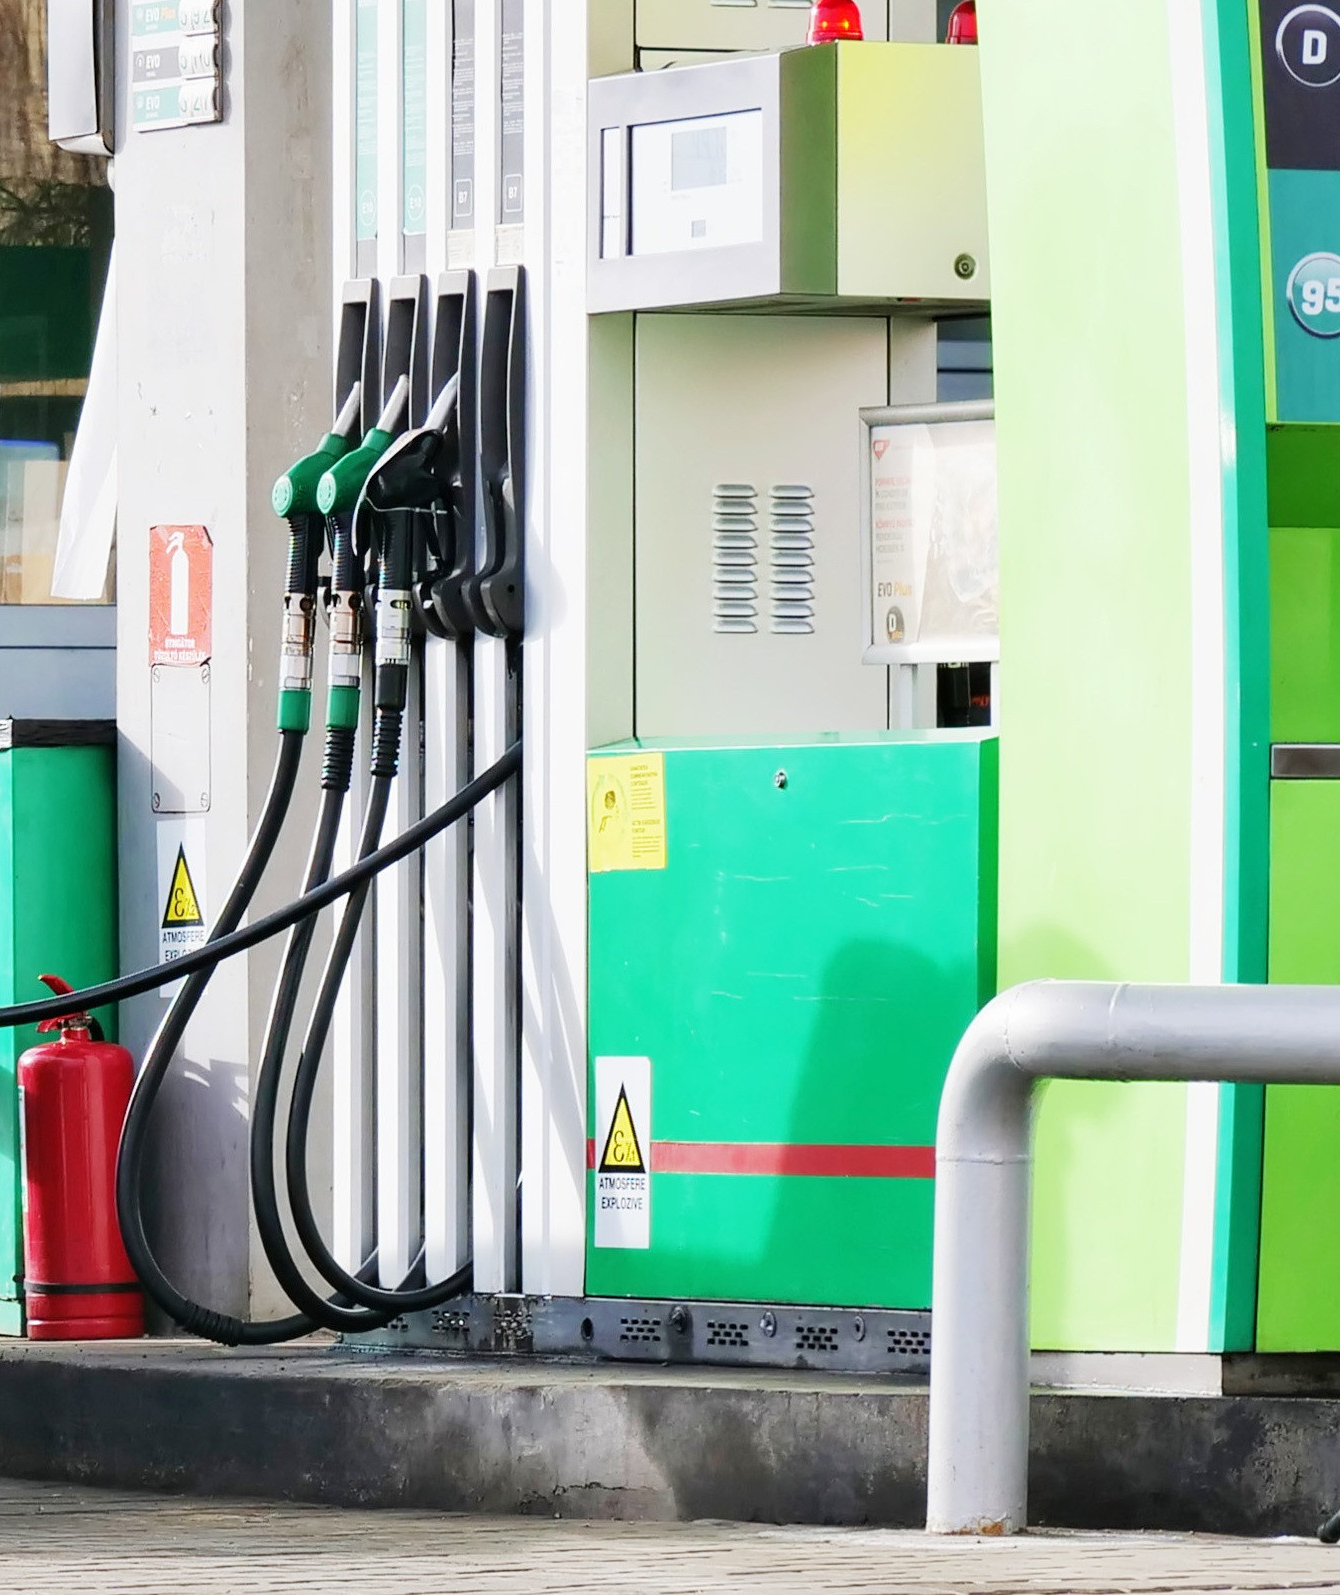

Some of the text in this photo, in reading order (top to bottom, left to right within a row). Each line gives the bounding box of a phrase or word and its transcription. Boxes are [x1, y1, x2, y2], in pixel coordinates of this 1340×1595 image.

[145, 8, 160, 23] EVO
[1301, 29, 1328, 65] D
[145, 54, 160, 69] EVO
[145, 95, 160, 110] EVO
[458, 191, 468, 204] B7
[508, 186, 518, 199] B7
[1301, 278, 1340, 315] 95
[877, 582, 893, 598] EVO
[162, 930, 205, 944] ATMOSFERE
[598, 1177, 646, 1191] ATMOSFERE
[601, 1196, 644, 1210] EXPLOZIVE
